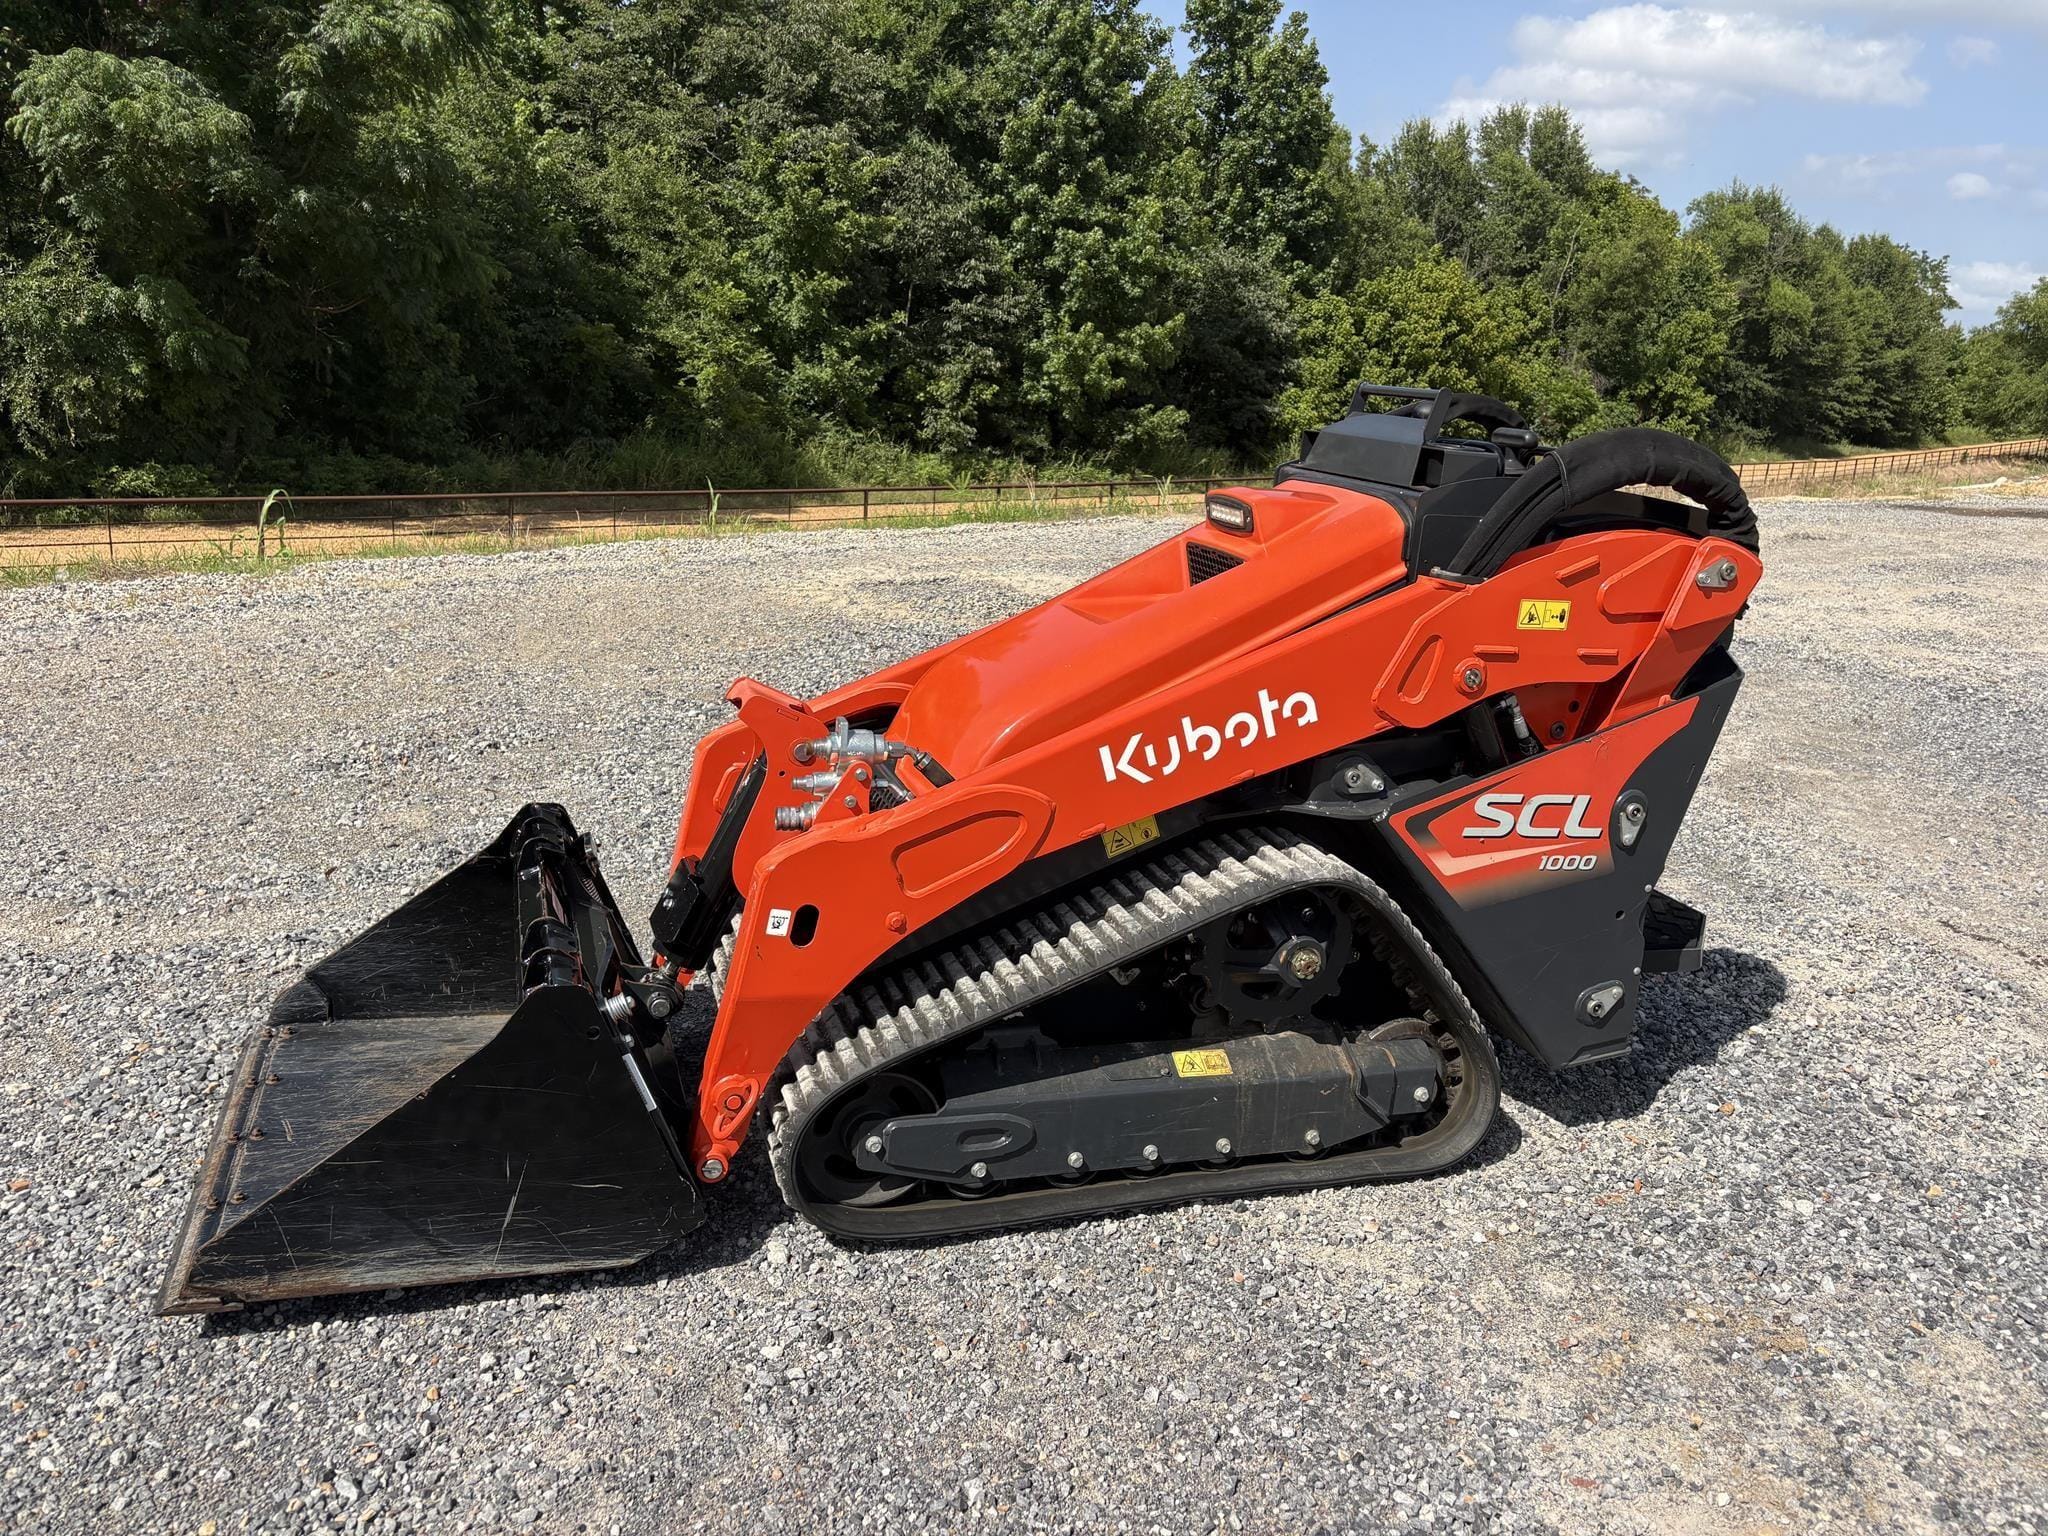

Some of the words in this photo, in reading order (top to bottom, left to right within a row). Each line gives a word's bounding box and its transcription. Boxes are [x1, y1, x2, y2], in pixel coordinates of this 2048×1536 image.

[1099, 689, 1318, 784] Kubota
[1462, 793, 1603, 839] SCL
[1538, 855, 1598, 871] 1000
